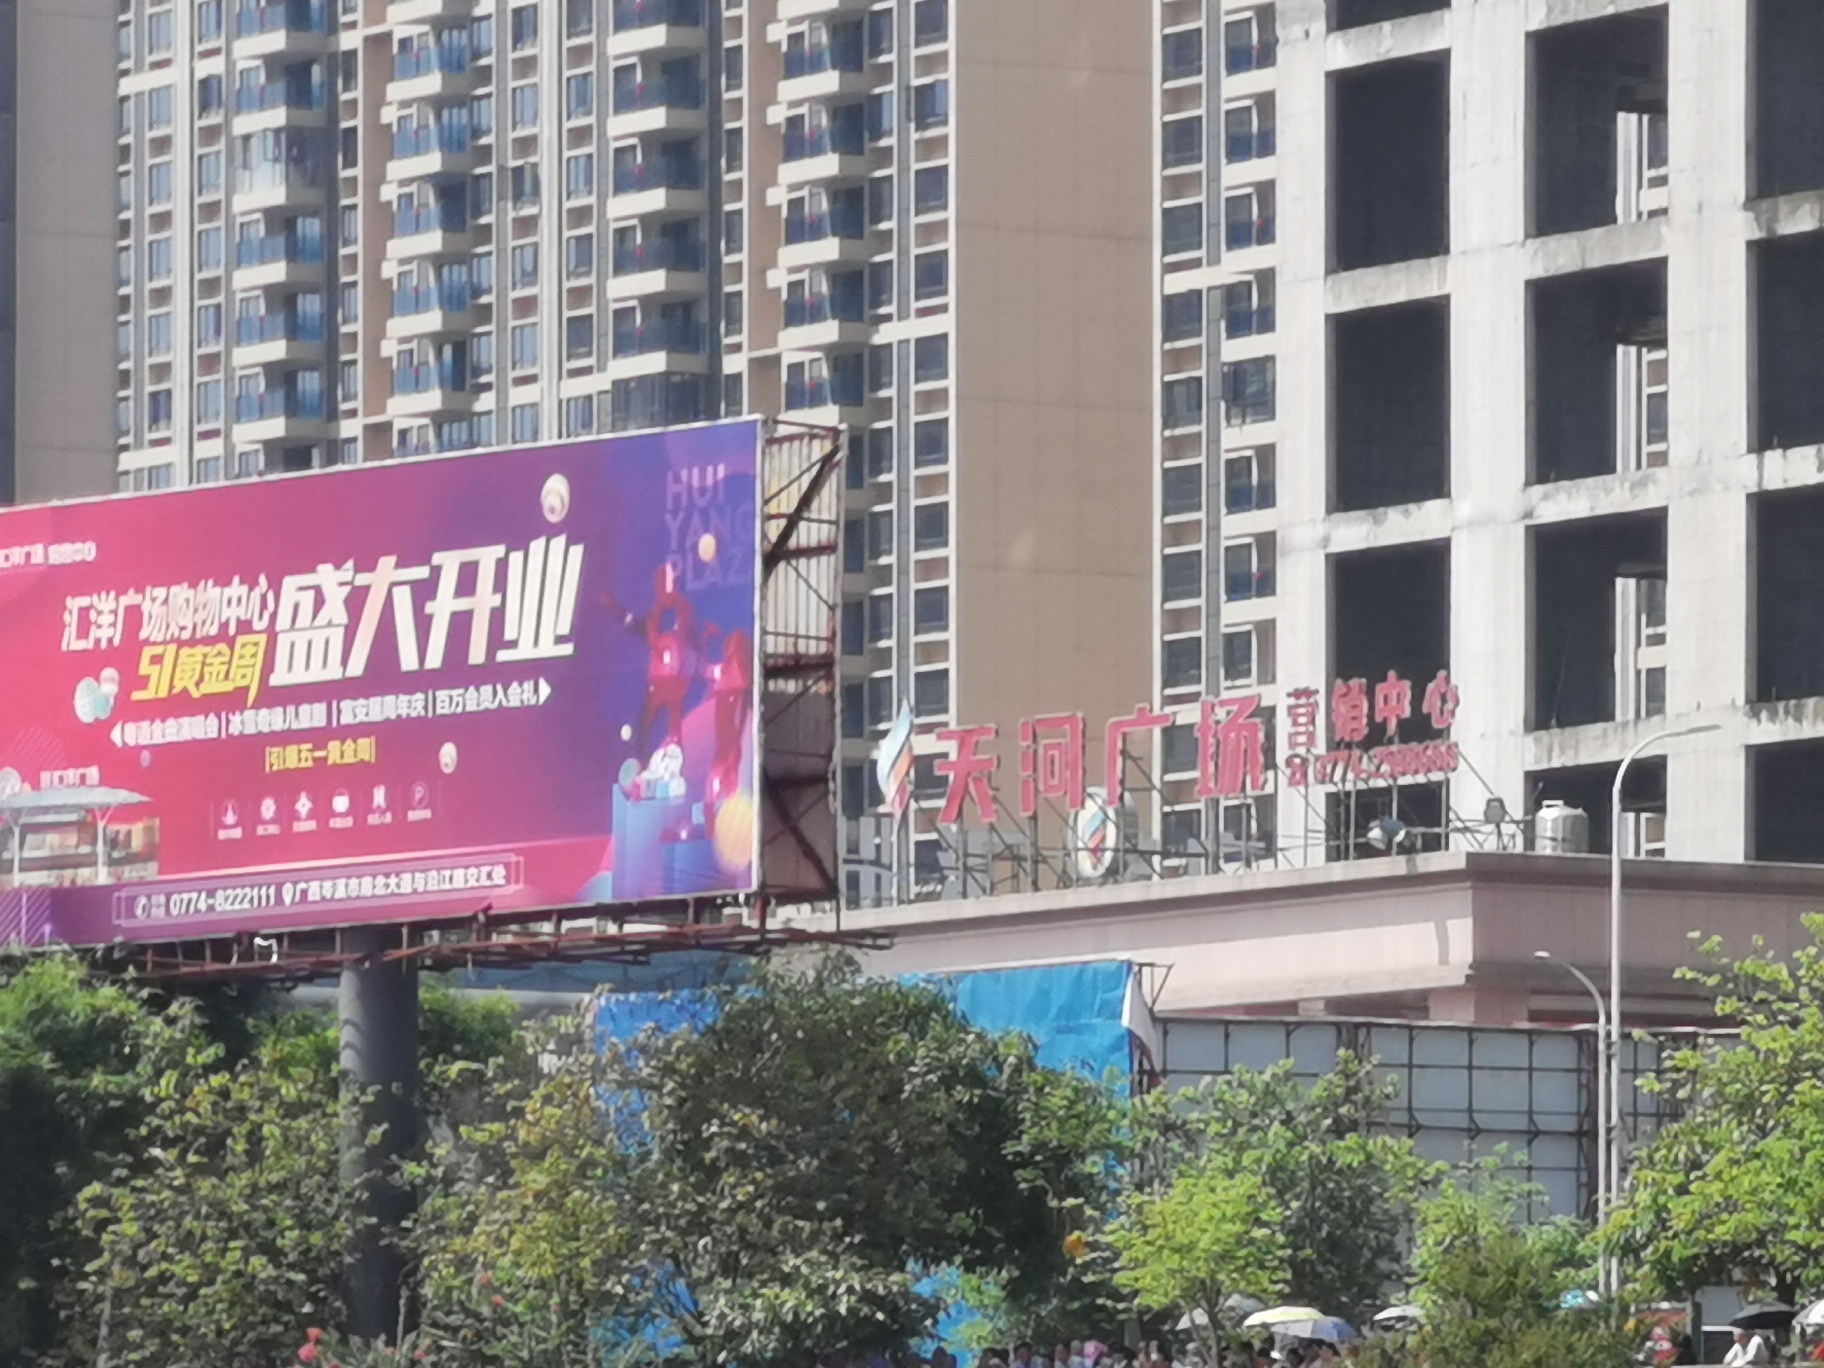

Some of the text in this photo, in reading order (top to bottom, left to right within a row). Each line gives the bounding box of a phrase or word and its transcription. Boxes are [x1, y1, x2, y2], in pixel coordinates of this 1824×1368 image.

[61, 572, 275, 652] 汇洋广场购物中心
[268, 533, 585, 688] 盛大开业
[1286, 669, 1460, 750] 营销中心
[934, 694, 1266, 824] 天河广场
[169, 882, 276, 917] 0774-8222111
